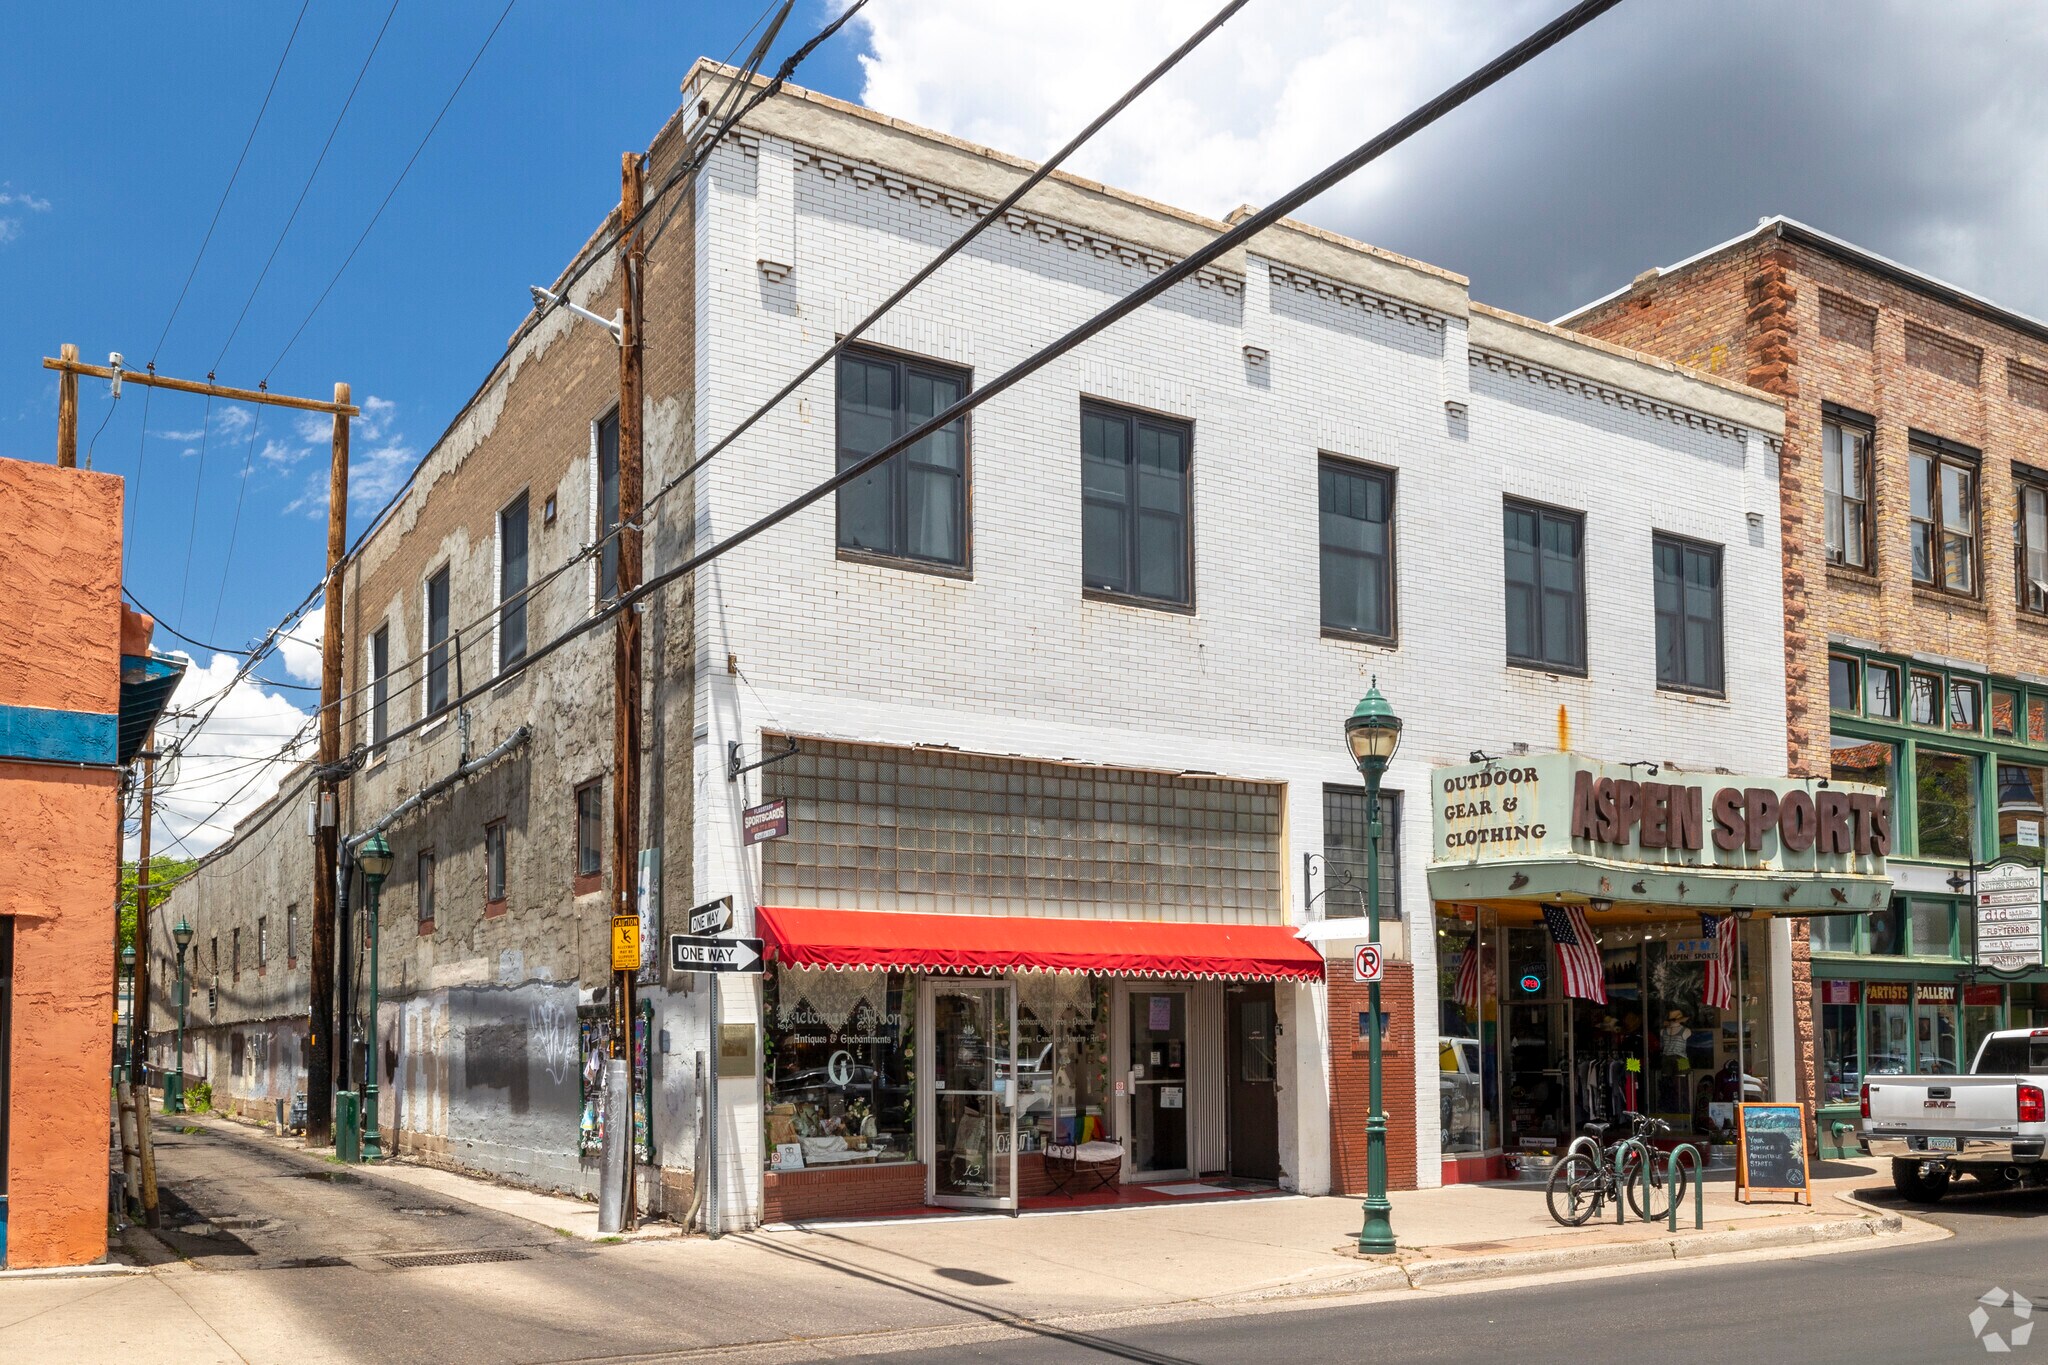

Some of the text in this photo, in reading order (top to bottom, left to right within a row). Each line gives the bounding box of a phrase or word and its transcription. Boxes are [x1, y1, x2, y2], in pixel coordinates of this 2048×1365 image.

[1444, 768, 1538, 793] OUTDOOR
[1445, 797, 1518, 820] GEAR &
[1571, 770, 1891, 856] ASPEN SPORTS
[745, 806, 784, 829] SPORTSCARDS
[1446, 824, 1546, 848] CLOTHING
[2002, 866, 2013, 876] 17
[615, 918, 638, 927] CAUTION
[692, 910, 720, 931] ONE WAY
[2003, 926, 2030, 934] TERROIR
[681, 946, 734, 962] ONE WAY
[1694, 952, 1718, 960] SPORTS
[1523, 979, 1538, 989] OPEN
[1870, 985, 1955, 999] ARTISTS GALLERY
[793, 1033, 827, 1046] Antiques
[840, 1033, 892, 1045] Enchantments
[1923, 1101, 1956, 1109] GMC
[963, 1164, 981, 1177] 13
